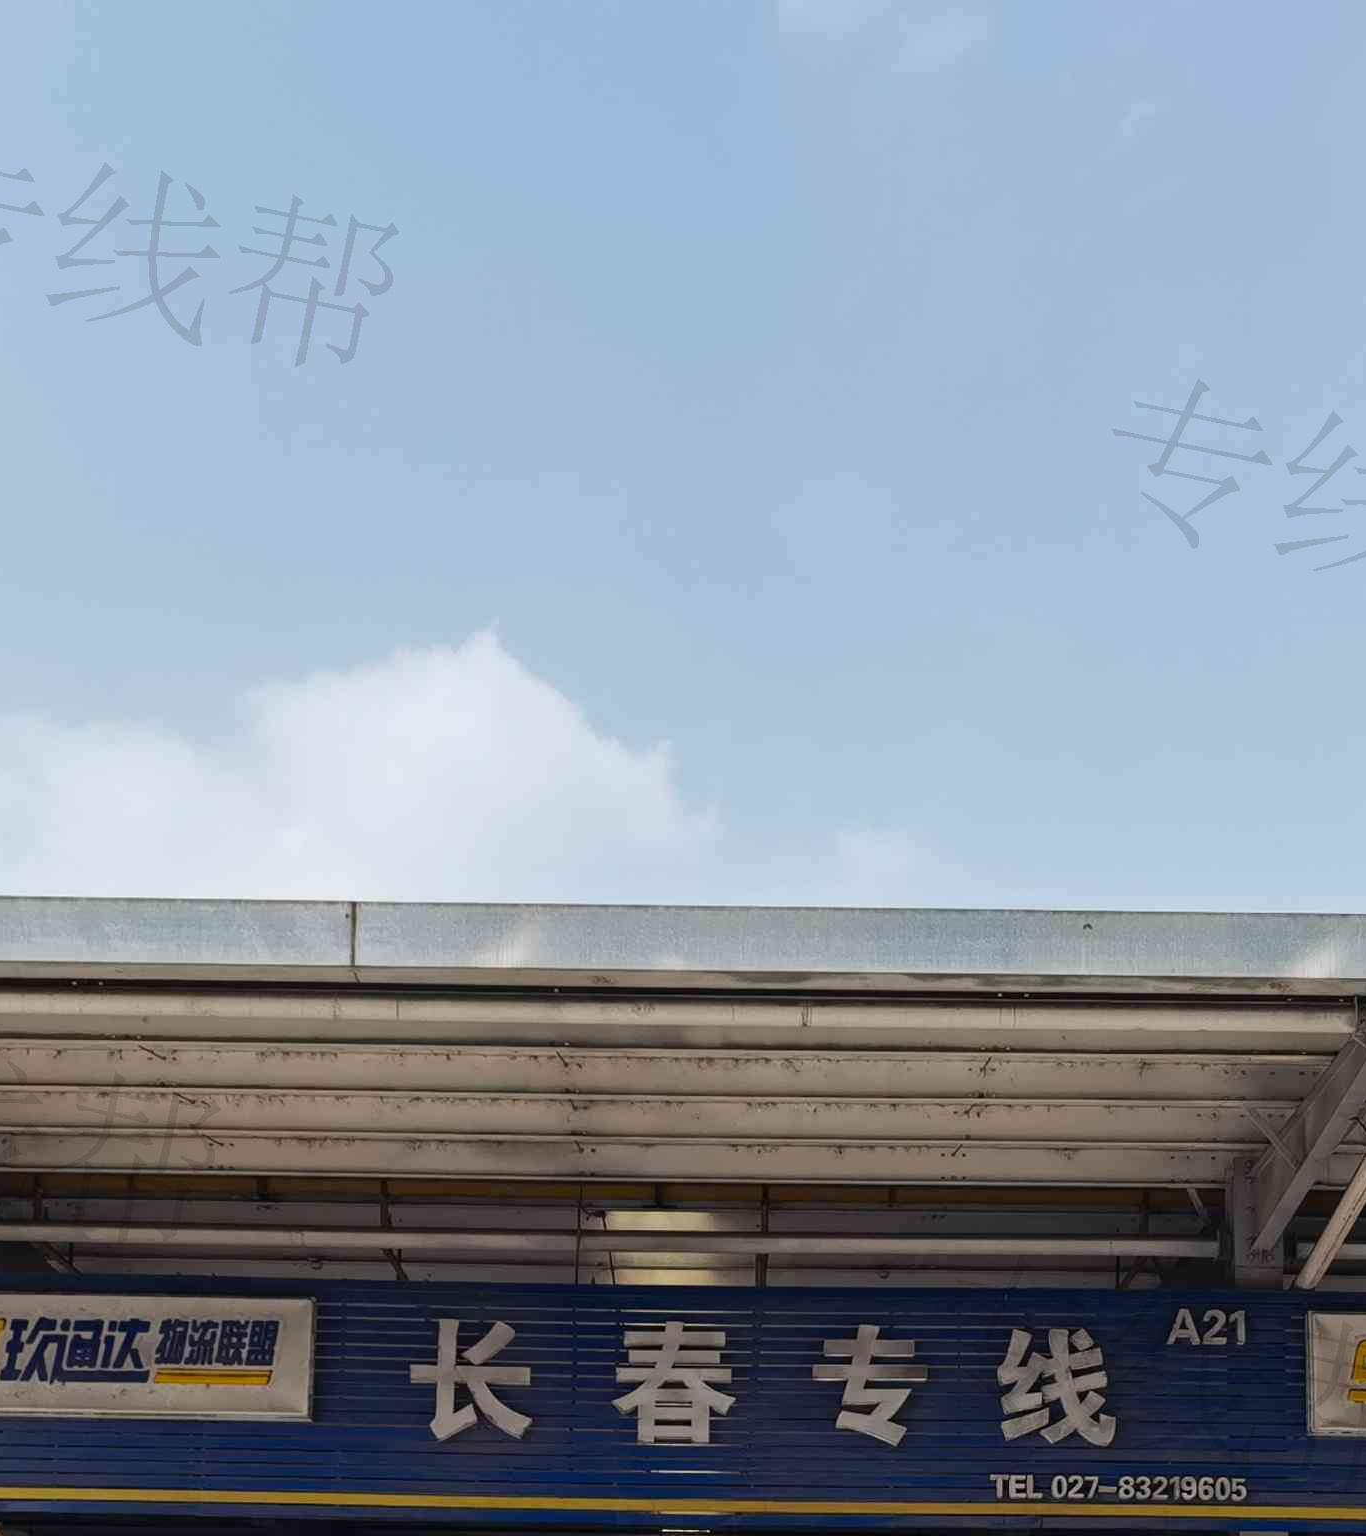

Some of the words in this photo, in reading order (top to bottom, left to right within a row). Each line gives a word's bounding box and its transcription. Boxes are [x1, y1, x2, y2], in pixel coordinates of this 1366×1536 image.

[1, 1318, 151, 1382] 玖通达
[157, 1318, 279, 1366] 物流联盟
[1166, 1308, 1247, 1346] A21
[409, 1318, 1116, 1447] 长春专线
[990, 1474, 1042, 1499] TEL
[1050, 1475, 1248, 1502] 027-83219605
